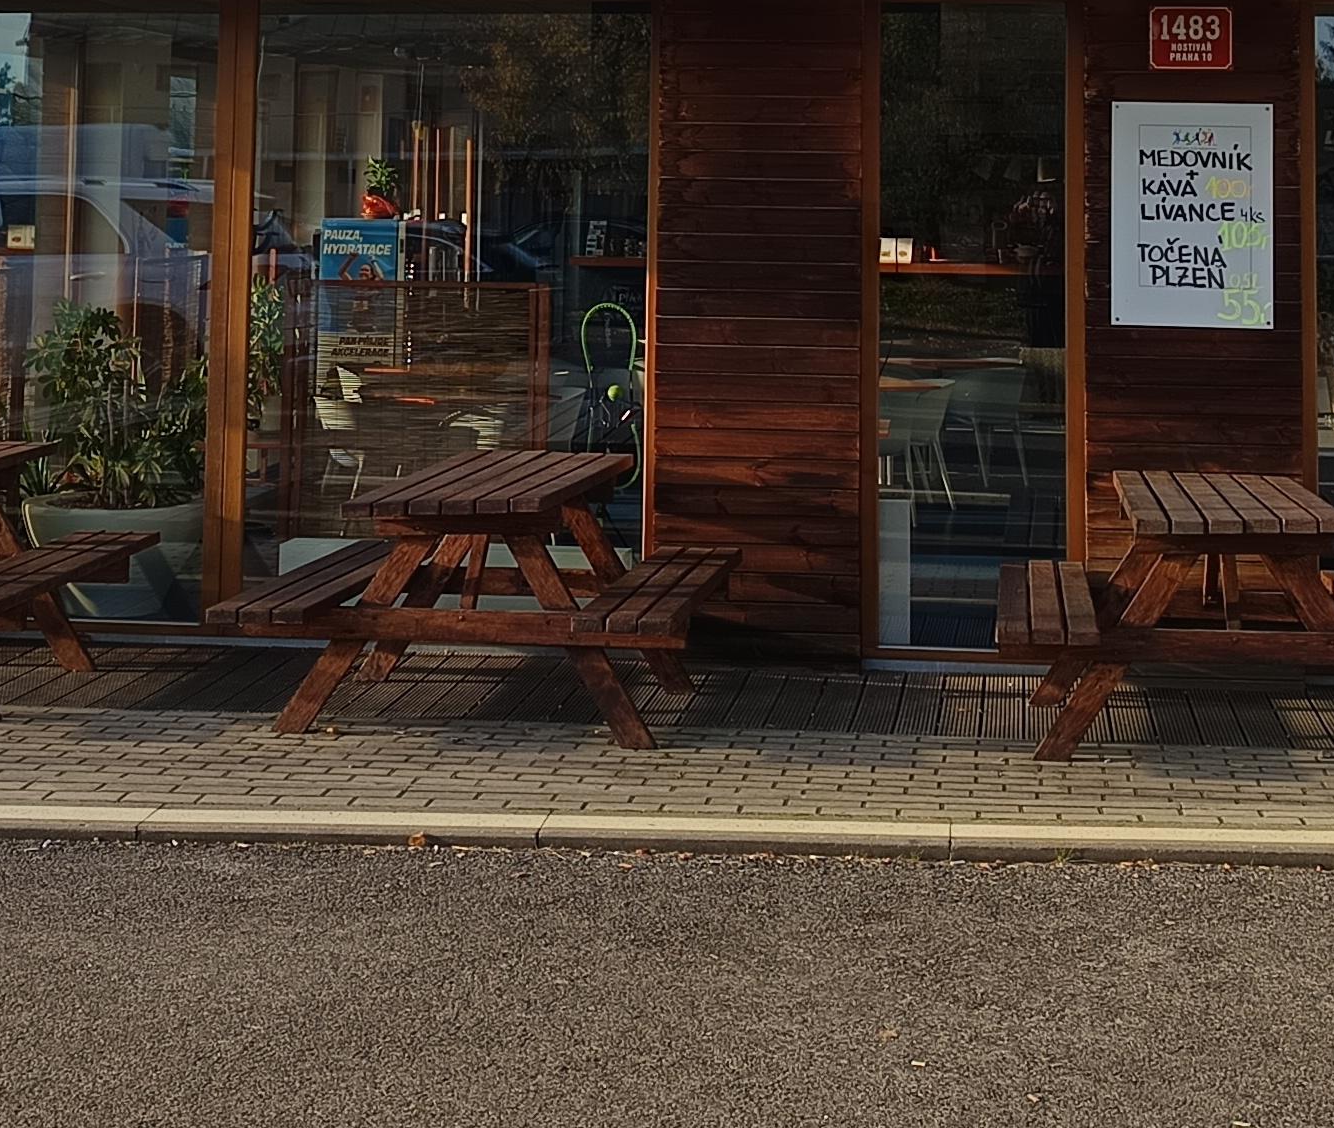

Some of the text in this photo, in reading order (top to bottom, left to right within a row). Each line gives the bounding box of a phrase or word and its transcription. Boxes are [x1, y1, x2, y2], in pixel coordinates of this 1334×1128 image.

[1160, 14, 1221, 41] 1483
[1169, 52, 1213, 62] PRAHA 10
[1170, 40, 1212, 52] HOSTIVAŘ
[1139, 143, 1253, 171] MEDOVNÍK
[1142, 172, 1198, 197] KÁVA
[1140, 197, 1236, 222] LÍVANCE
[323, 229, 364, 242] PAUZA,
[323, 244, 393, 256] HYDRATACE
[1137, 235, 1228, 269] TOČENÁ
